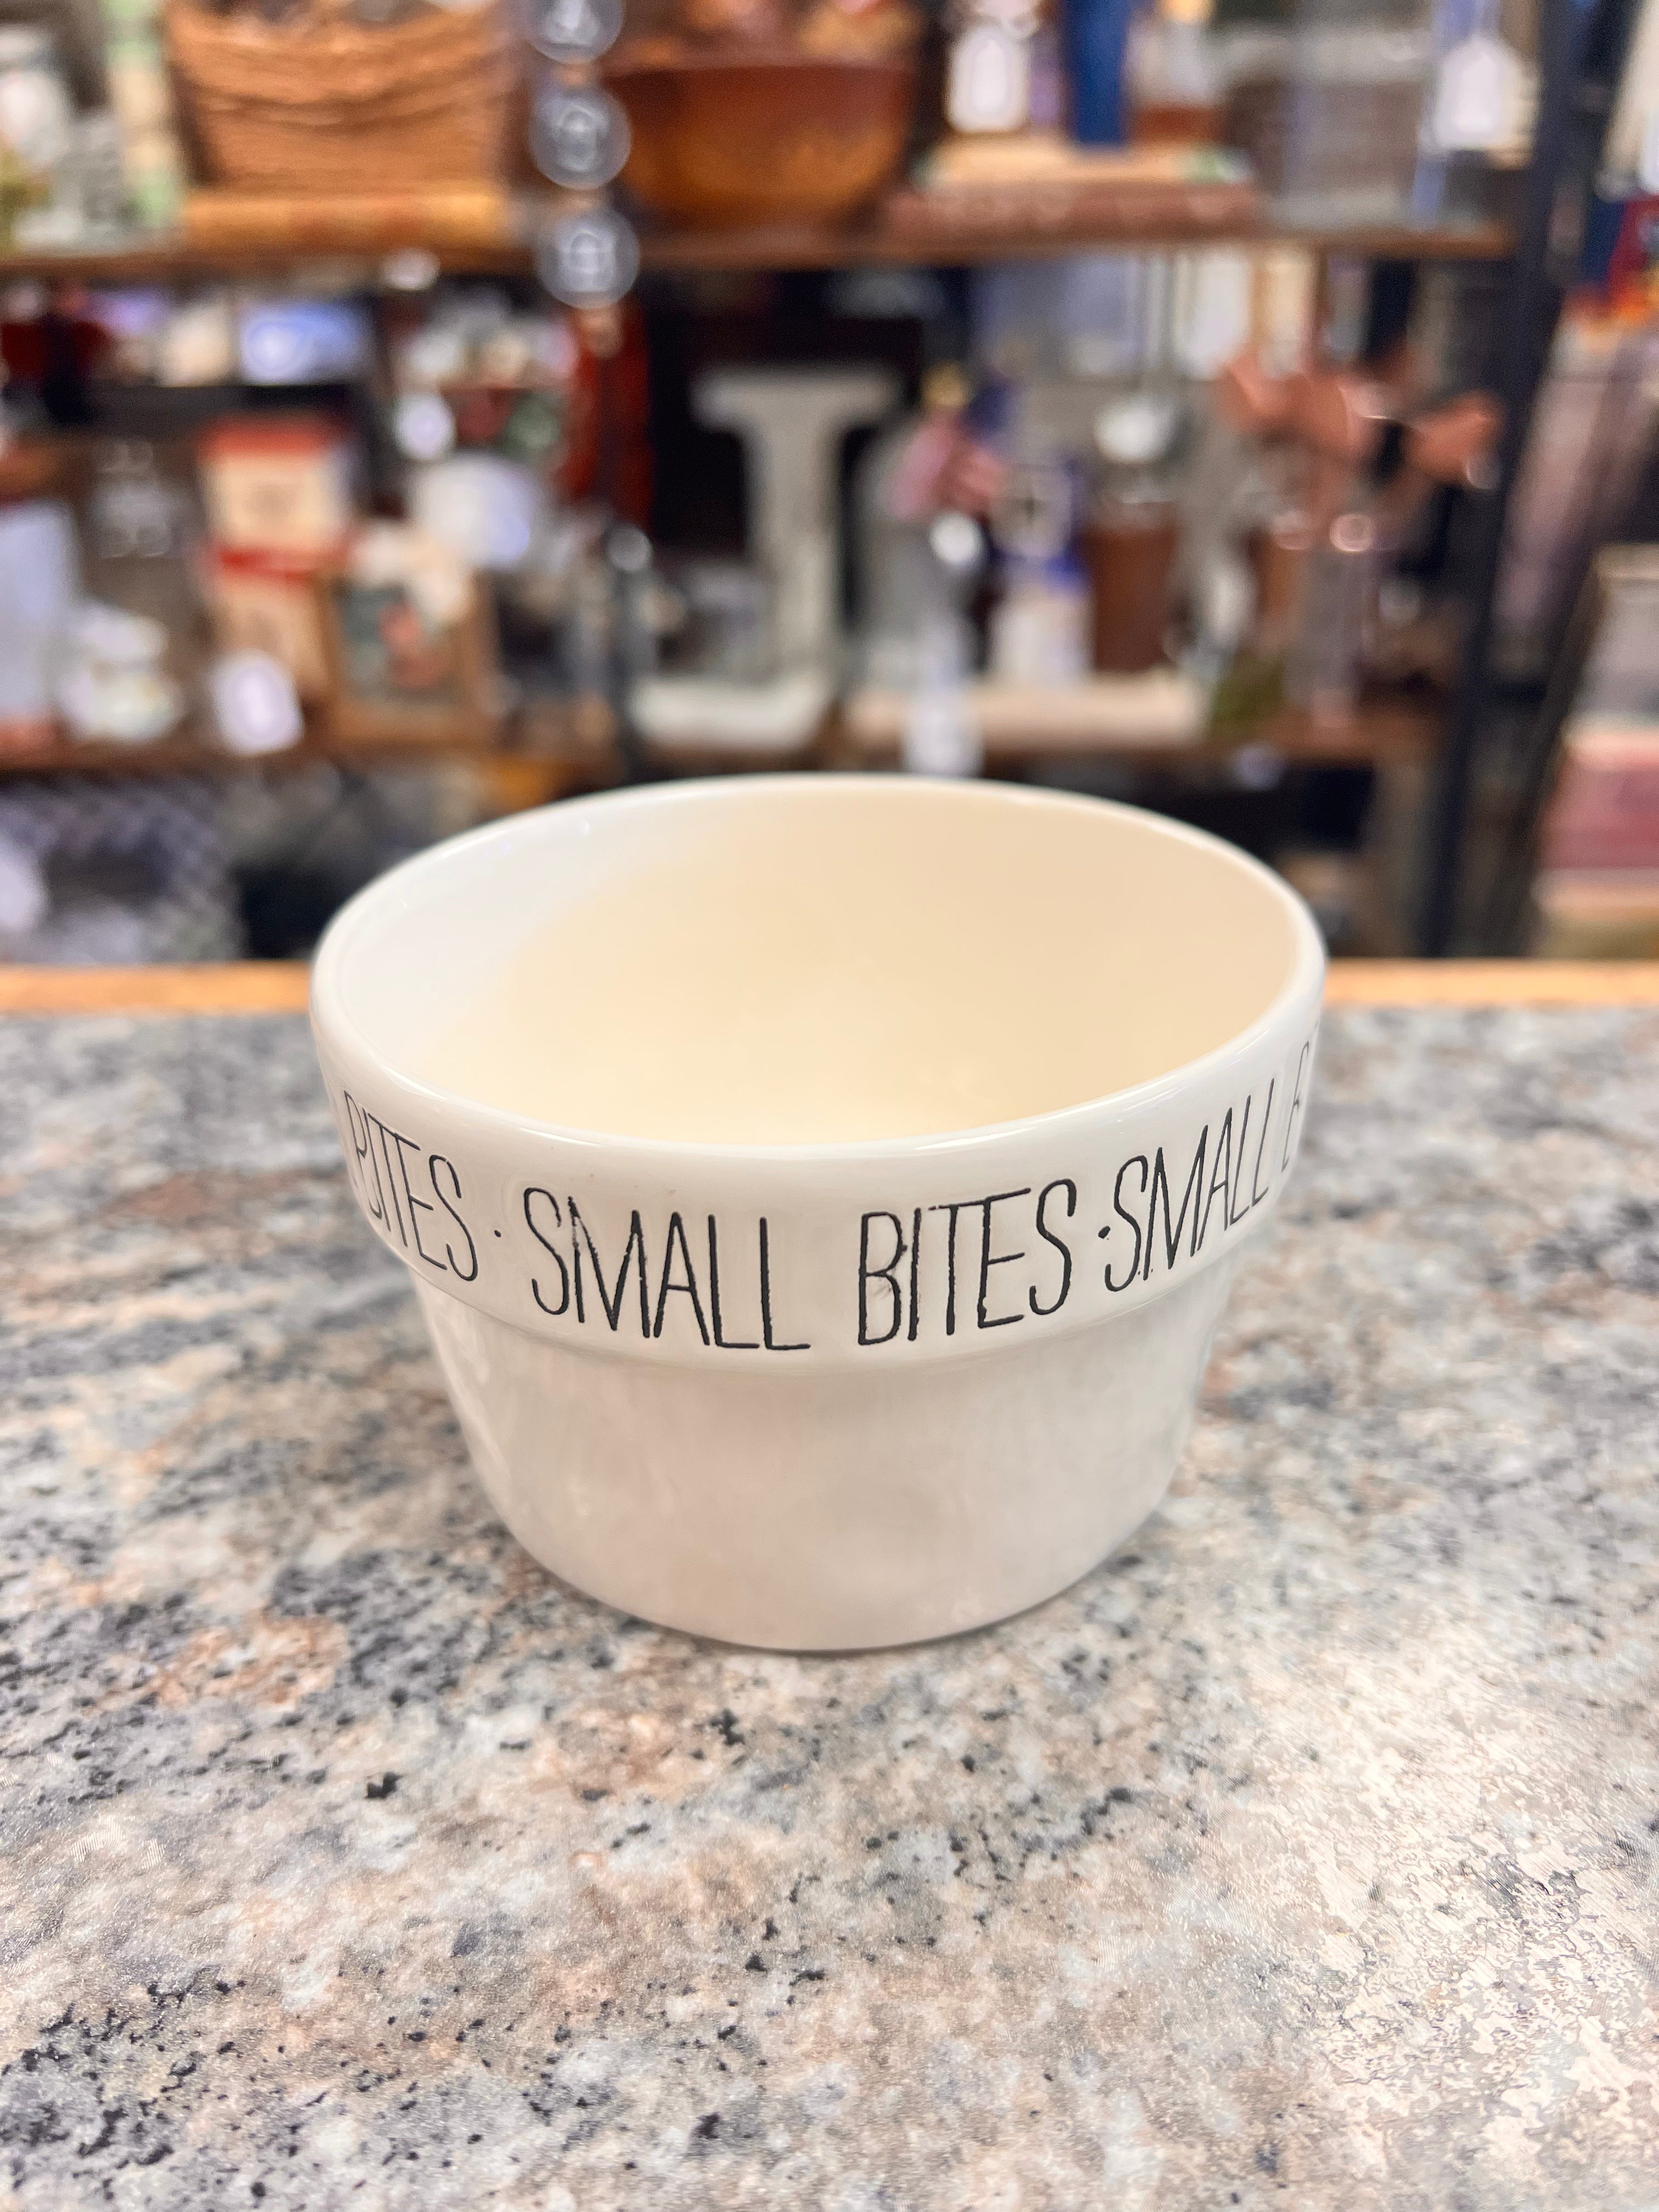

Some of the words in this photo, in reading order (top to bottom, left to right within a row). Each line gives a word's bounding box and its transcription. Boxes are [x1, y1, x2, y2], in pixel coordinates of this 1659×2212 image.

[523, 1187, 811, 1350] SMALL
[857, 1178, 1077, 1346] BITES
[1104, 1077, 1274, 1292] SMALL
